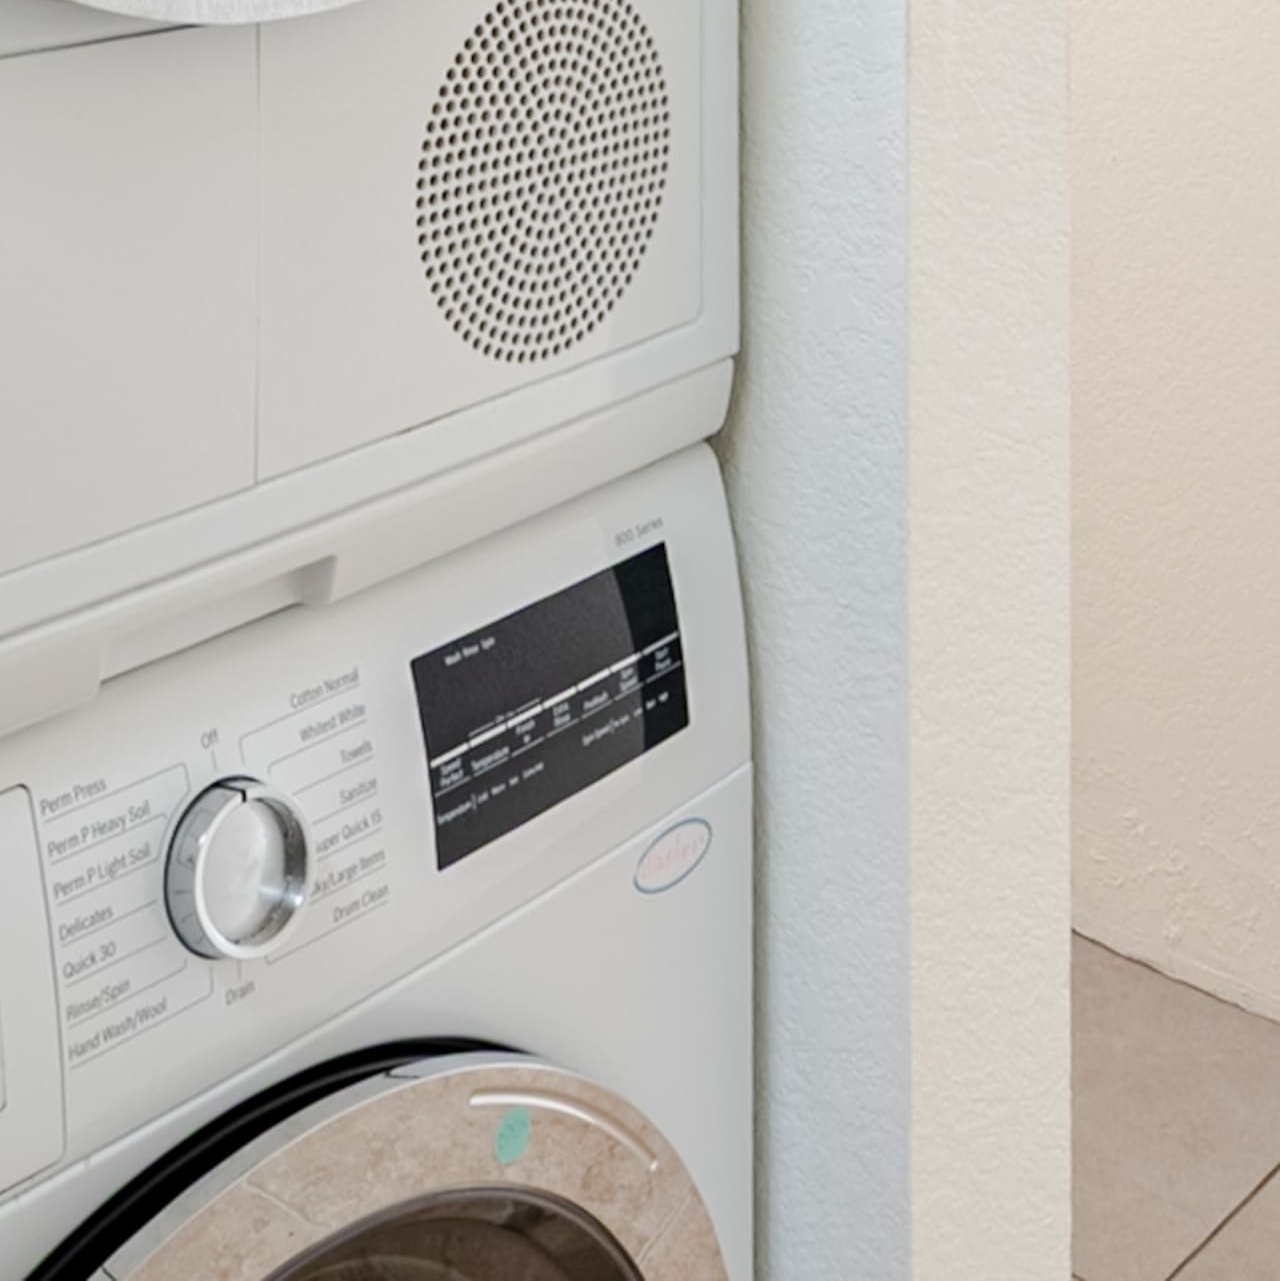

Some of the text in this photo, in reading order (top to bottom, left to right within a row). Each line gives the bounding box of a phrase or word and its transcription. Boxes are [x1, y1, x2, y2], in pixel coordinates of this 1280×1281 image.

[289, 665, 360, 710] Cotton Normal
[199, 726, 219, 751] Off
[40, 778, 107, 817] Perm Press
[47, 799, 151, 858] Perm P Heavy Soil
[341, 814, 370, 841] Quick
[53, 840, 152, 899] Perm P Light Soil
[58, 905, 114, 941] Delicates
[333, 882, 389, 924] Drum Clean
[62, 939, 117, 980] Quick 30
[65, 978, 131, 1023] Rinse/Spin
[225, 980, 257, 1008] Drain
[67, 994, 168, 1061] Hand Wash/Wool
